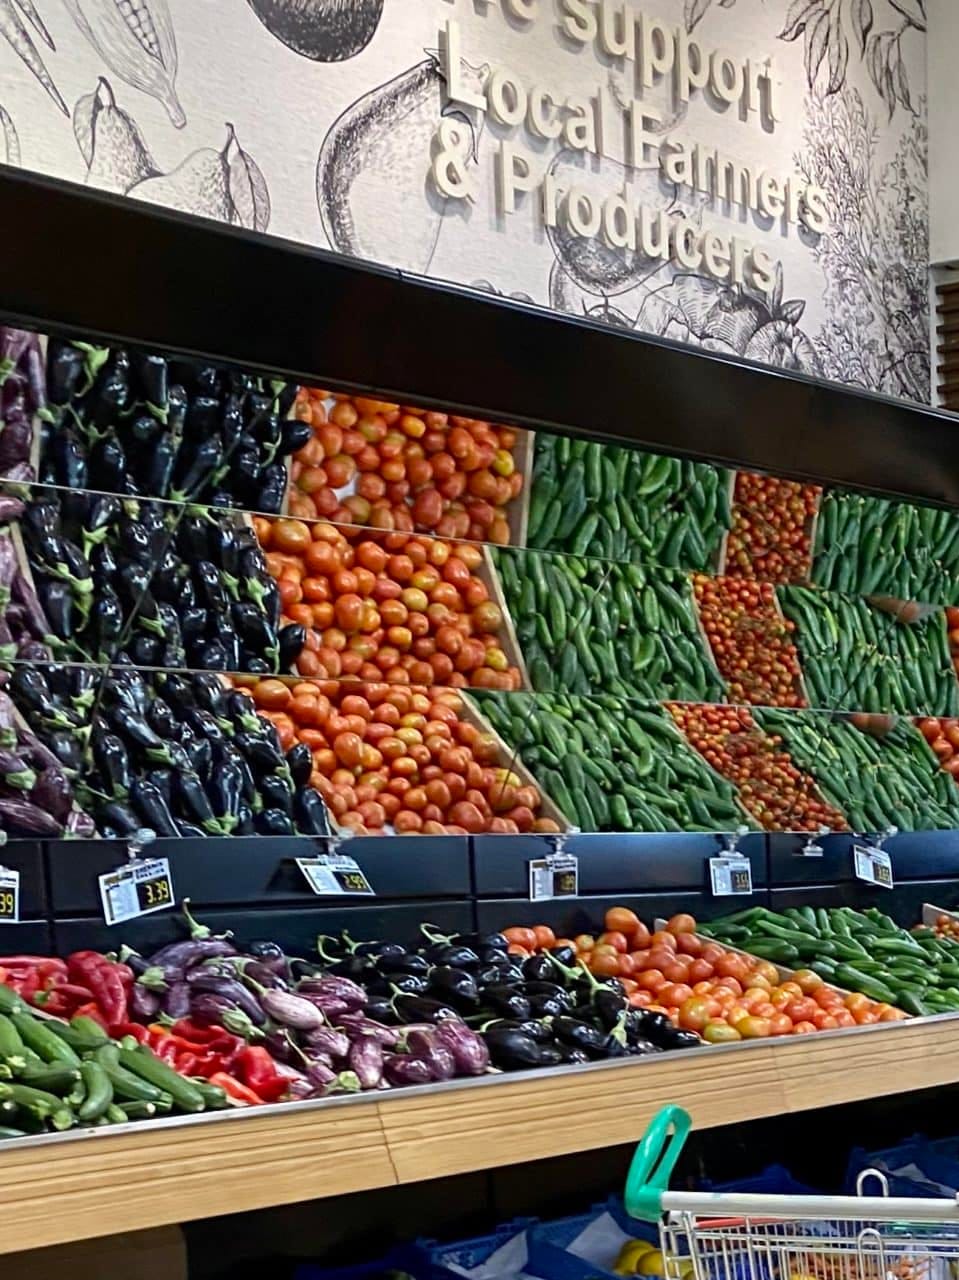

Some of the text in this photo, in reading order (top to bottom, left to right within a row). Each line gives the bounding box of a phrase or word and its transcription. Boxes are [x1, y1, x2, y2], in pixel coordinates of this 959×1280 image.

[443, 19, 831, 235] Local Farmers
[562, 0, 779, 123] support
[432, 117, 777, 293] & Producers
